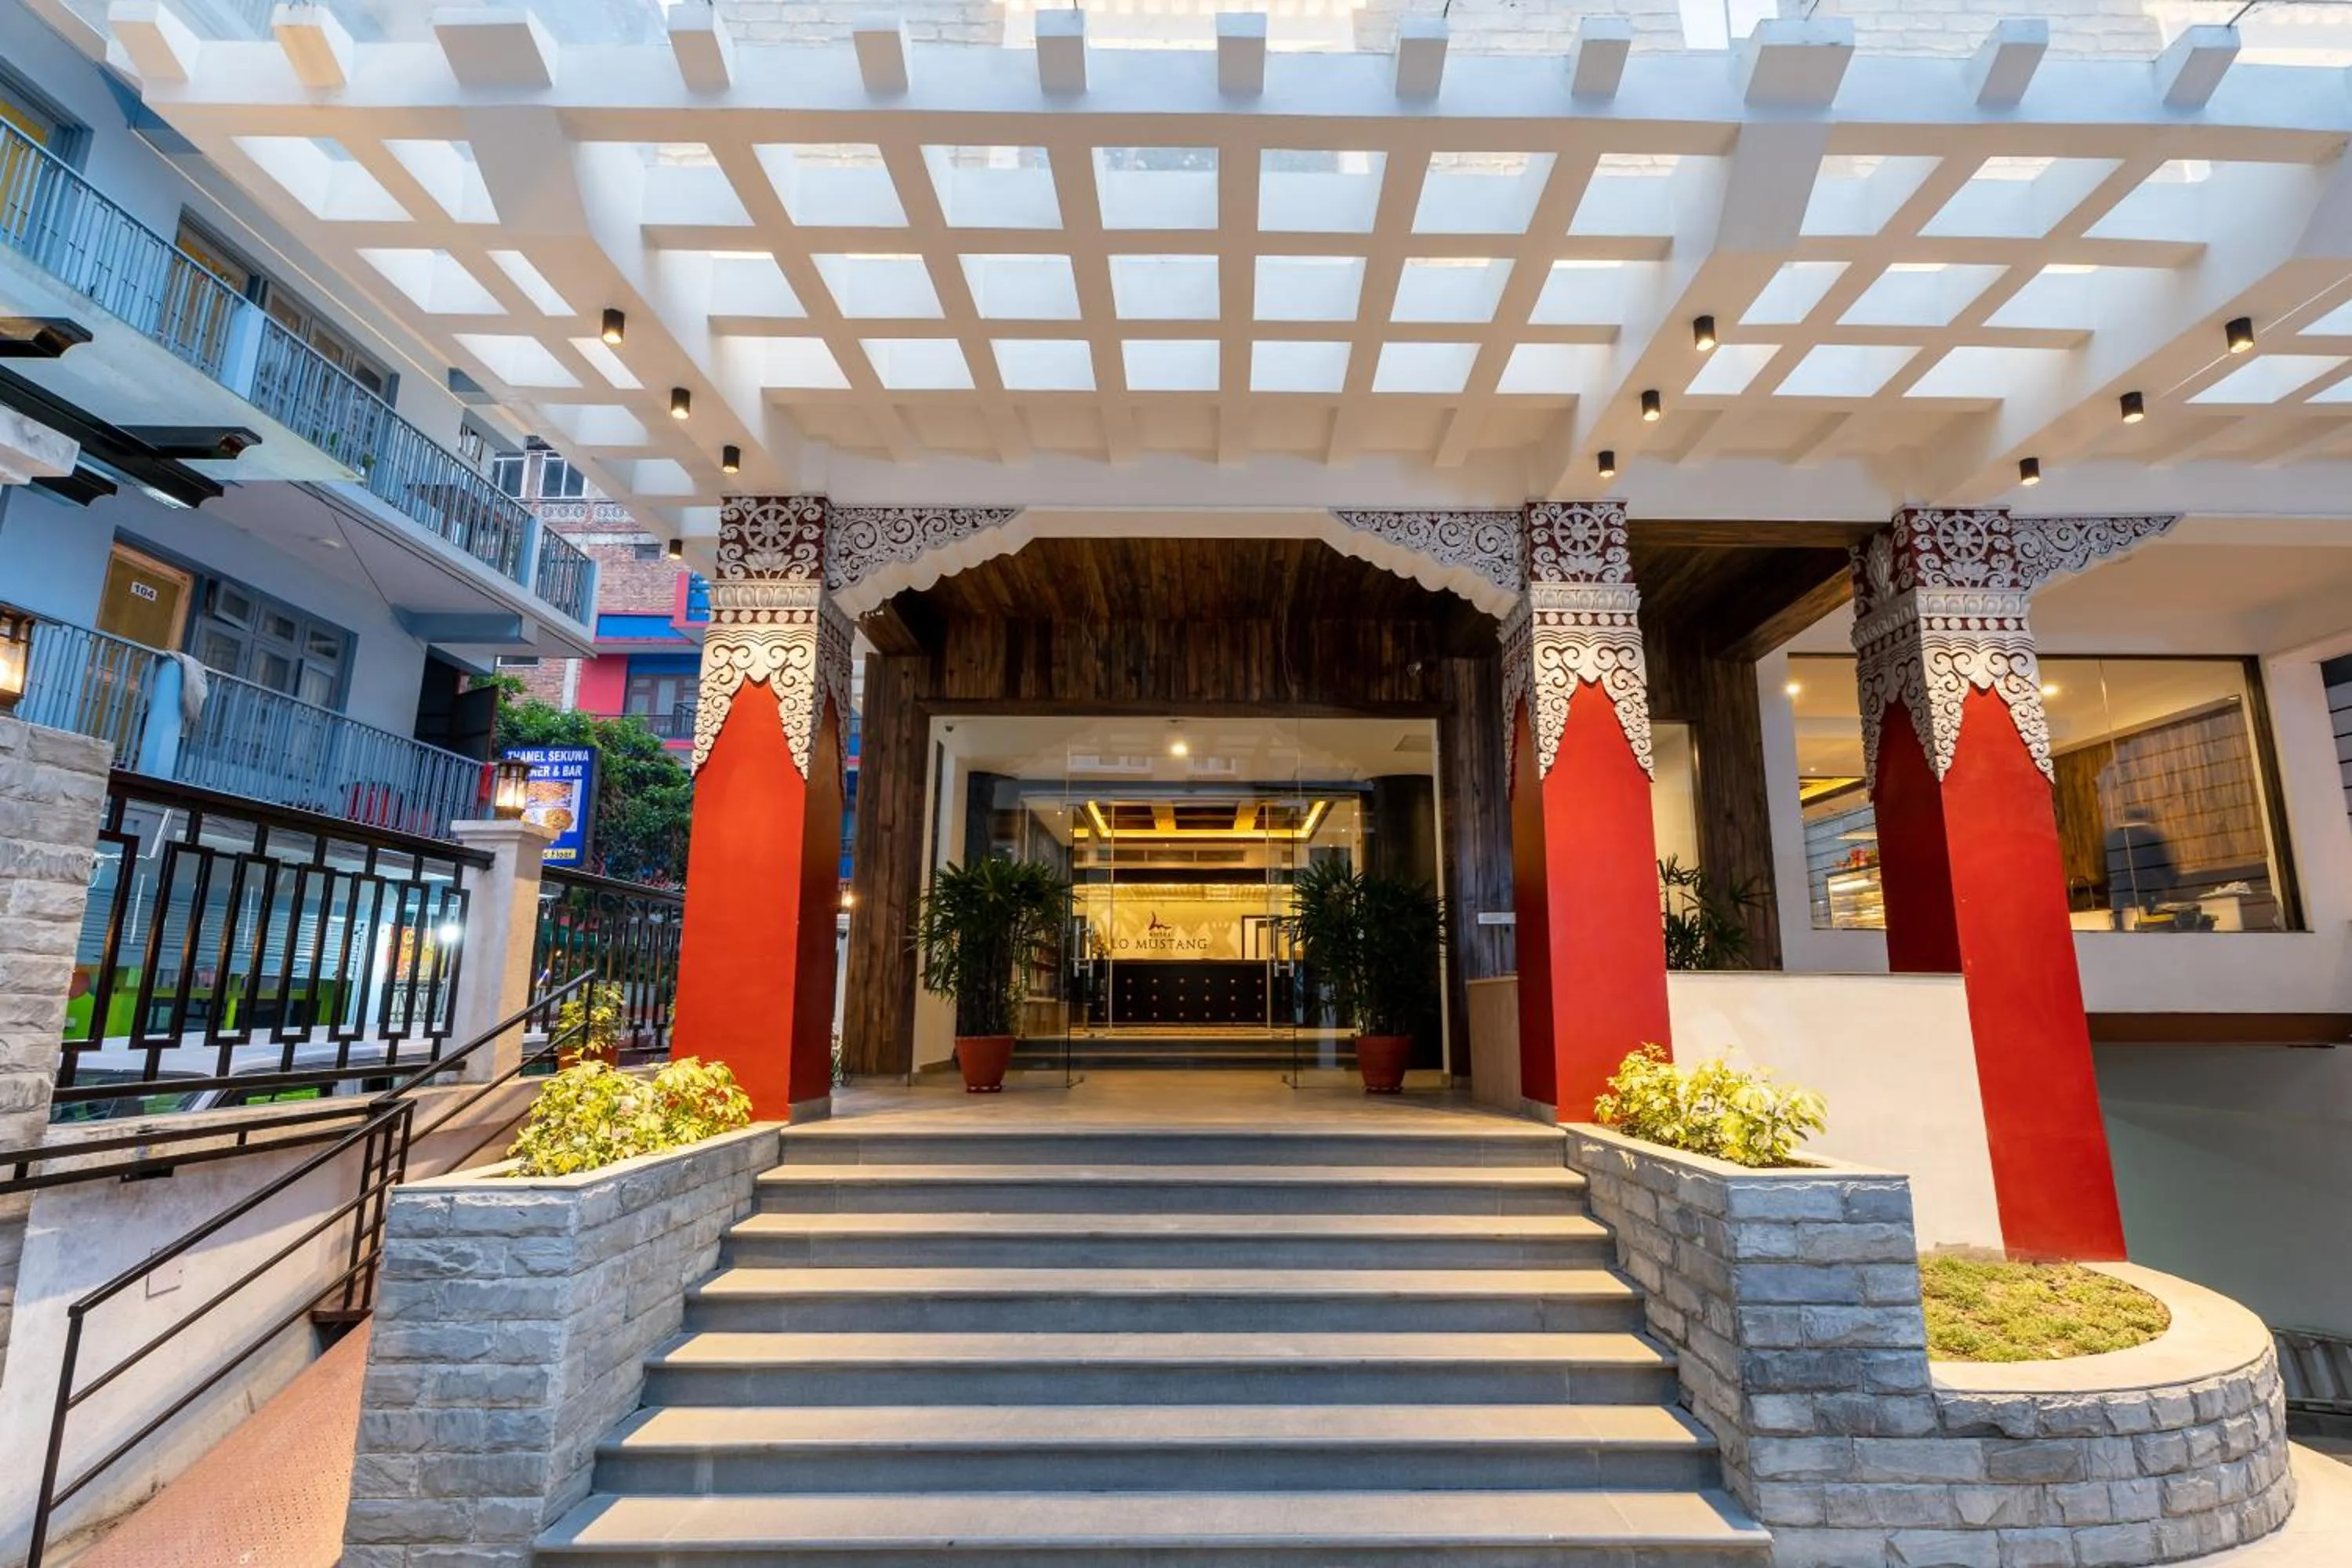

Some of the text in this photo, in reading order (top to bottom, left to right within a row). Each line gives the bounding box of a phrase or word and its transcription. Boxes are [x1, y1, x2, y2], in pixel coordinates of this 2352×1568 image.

[134, 584, 154, 598] 104
[507, 750, 589, 762] THAMEL SEKUWA
[553, 765, 560, 776] &
[563, 765, 583, 776] BAR
[1111, 938, 1207, 949] LO MUSTANG
